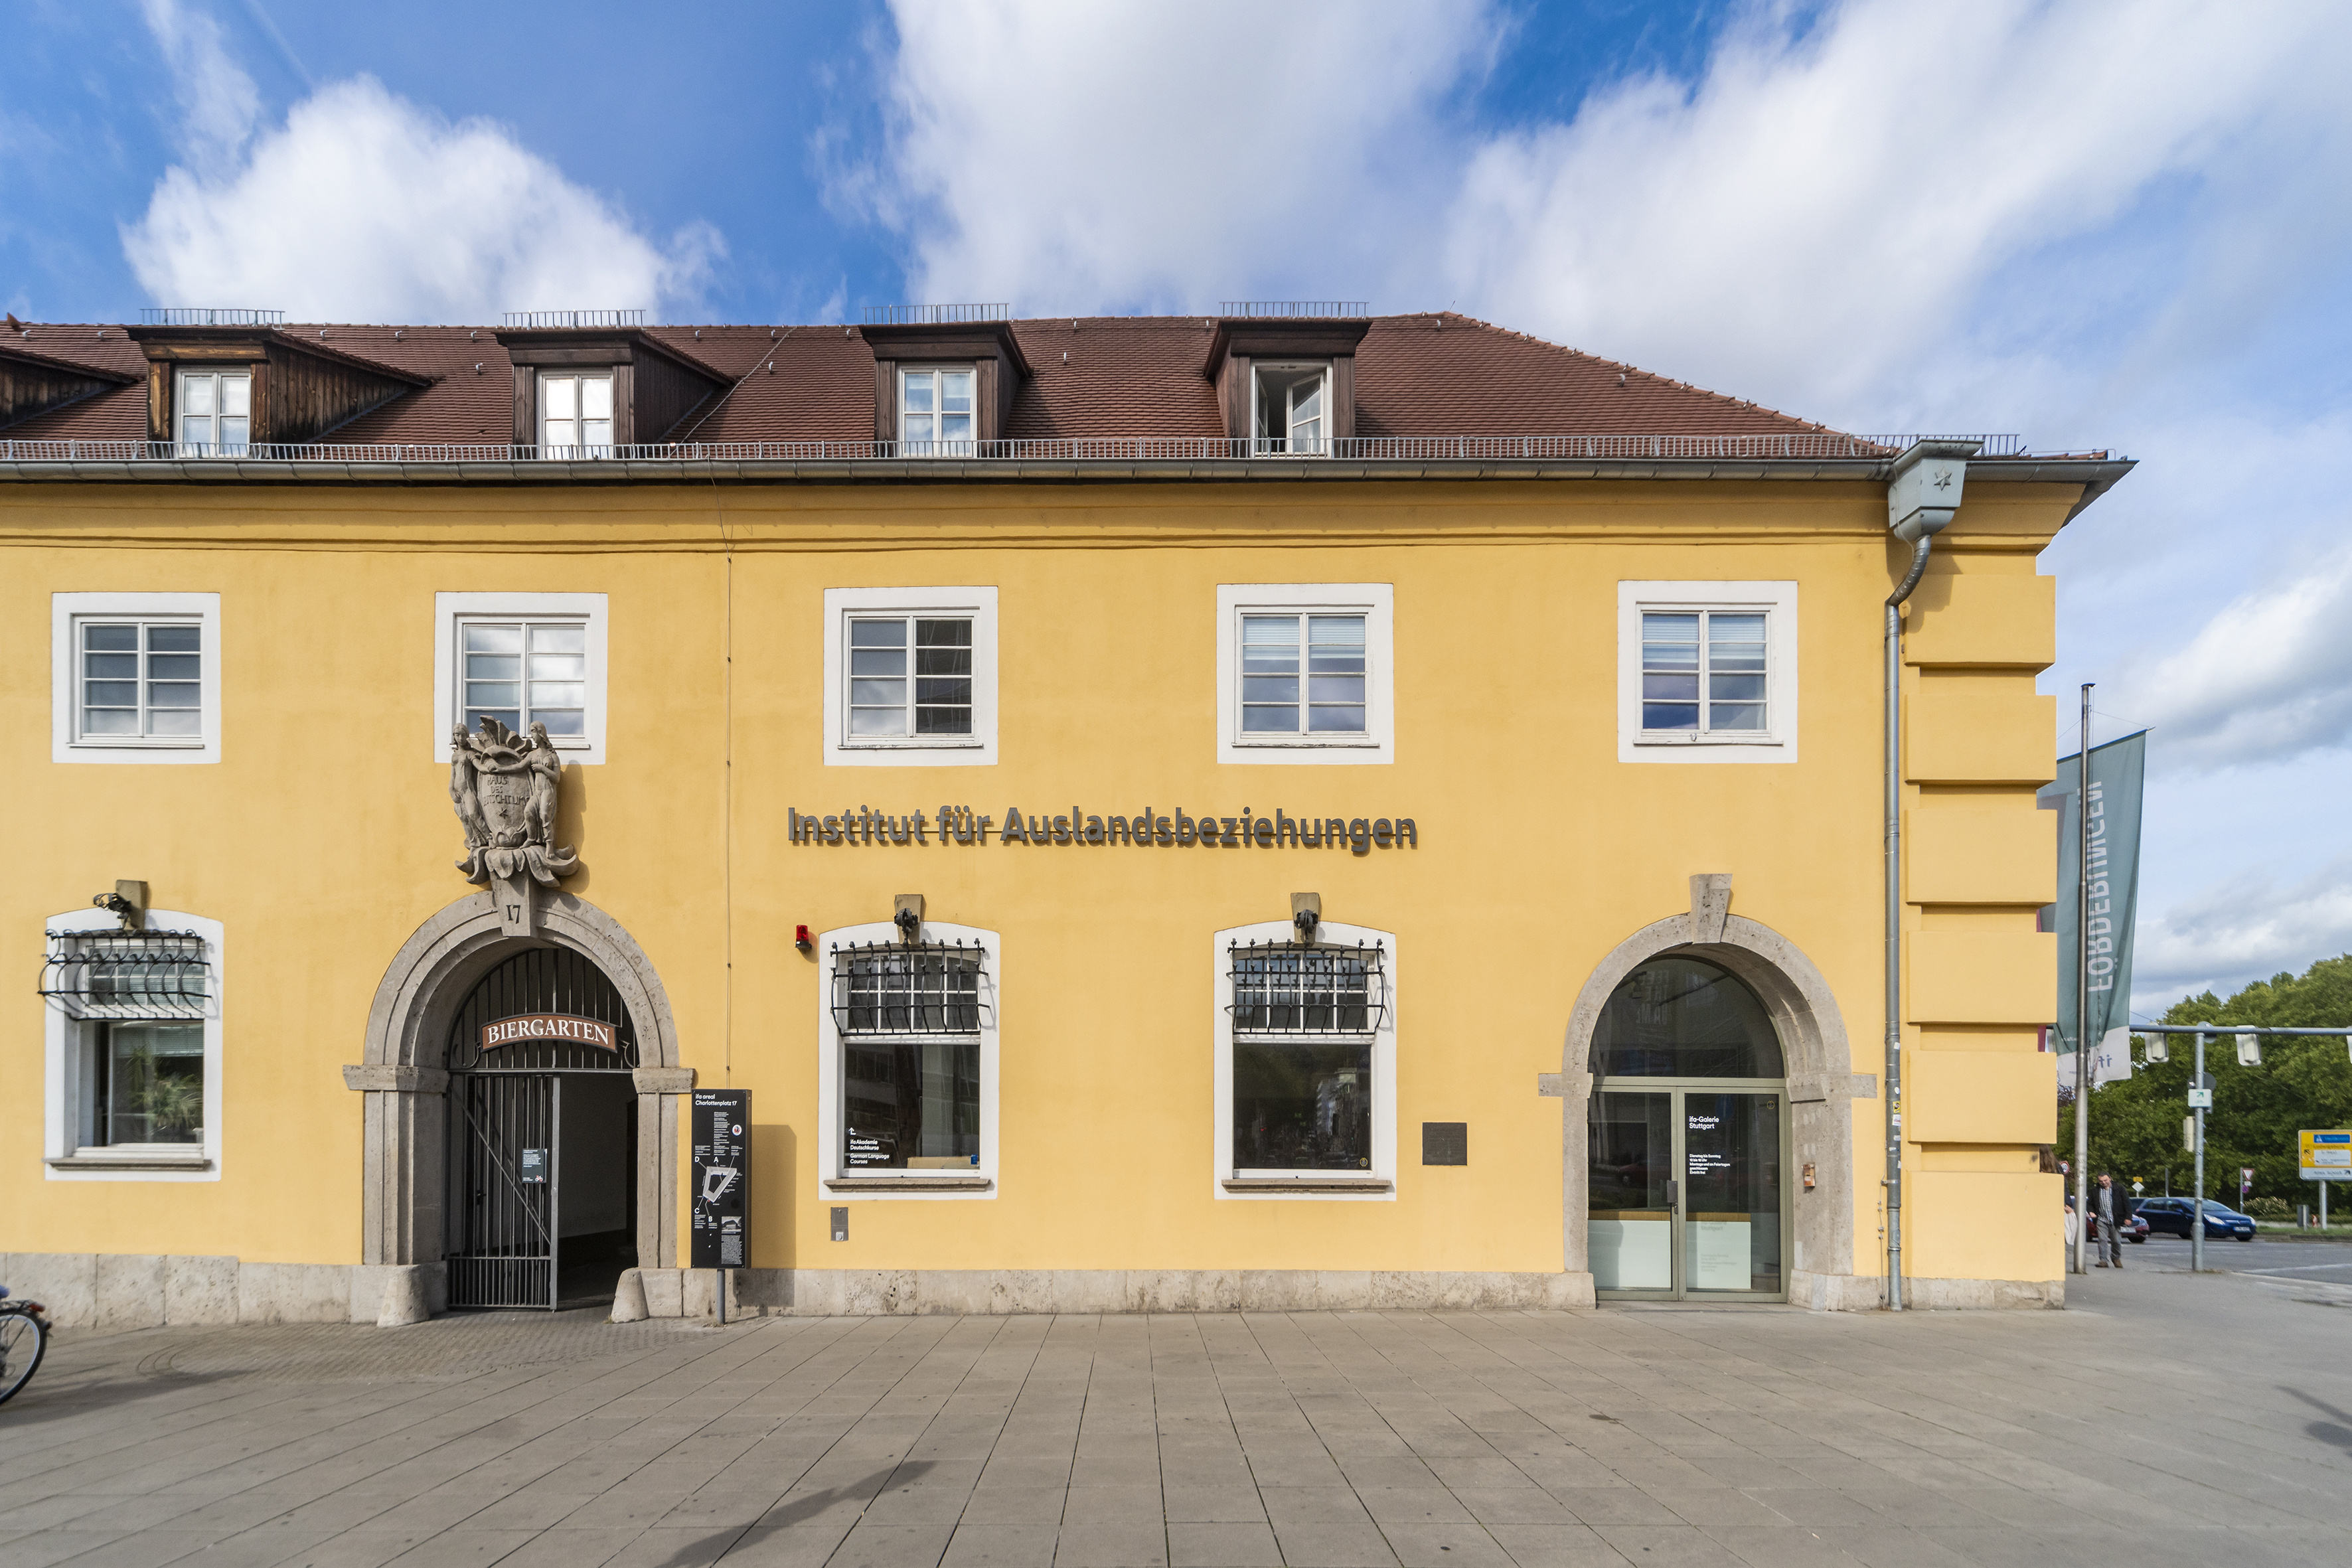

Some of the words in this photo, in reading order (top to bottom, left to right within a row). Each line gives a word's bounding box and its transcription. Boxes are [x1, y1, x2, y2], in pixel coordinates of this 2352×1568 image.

[487, 776, 508, 785] HAUS
[787, 805, 925, 842] Institut
[937, 805, 990, 842] für
[1001, 806, 1417, 854] Auslandsbeziehungen
[506, 905, 521, 924] 17
[487, 1019, 609, 1045] BIERGARTEN
